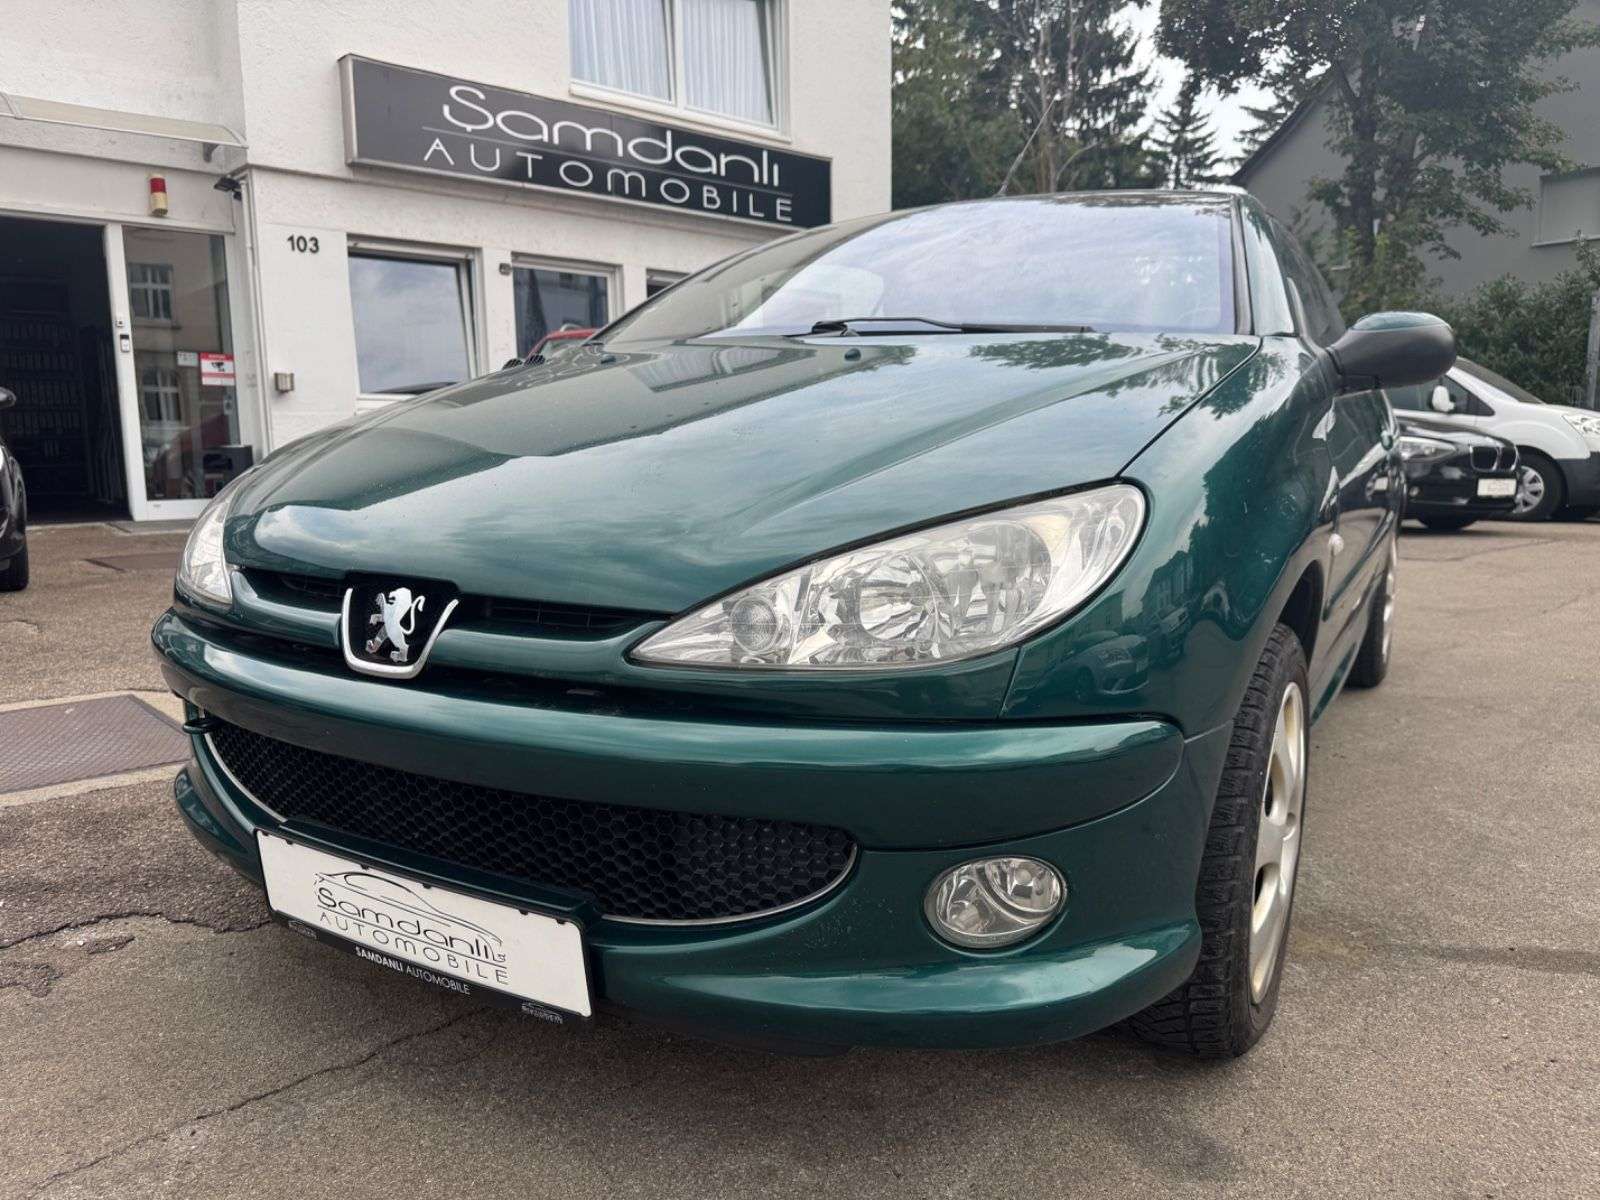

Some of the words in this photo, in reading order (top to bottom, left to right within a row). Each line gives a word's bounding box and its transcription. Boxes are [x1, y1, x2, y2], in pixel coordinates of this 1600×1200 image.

[423, 137, 793, 222] AUTOMOBILE
[287, 234, 320, 254] 103
[320, 911, 509, 986] AUTOMOBILE
[355, 946, 404, 973] SAMDANLI
[405, 965, 471, 996] AUTOMOBILE
